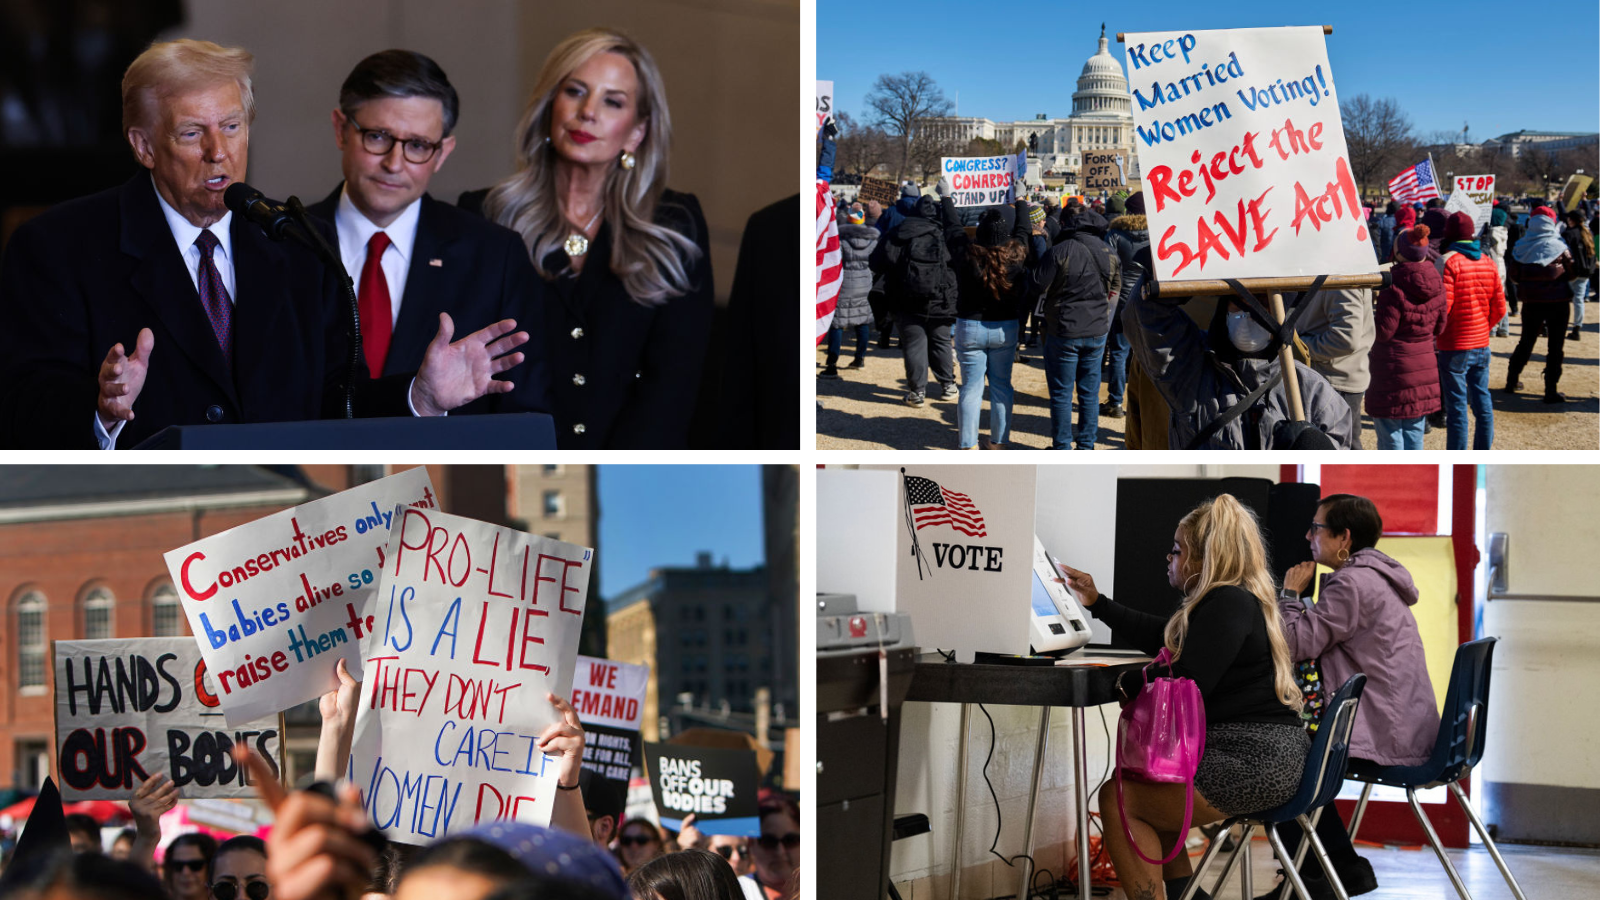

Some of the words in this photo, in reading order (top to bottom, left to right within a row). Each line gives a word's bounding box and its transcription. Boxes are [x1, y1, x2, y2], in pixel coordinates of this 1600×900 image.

[1127, 33, 1196, 70] Keep
[1132, 51, 1244, 112] Married
[1137, 101, 1232, 147] Women
[1237, 64, 1330, 111] Voting!
[945, 157, 1008, 172] CONGRESS?
[952, 171, 1014, 190] COWARDS!
[1085, 152, 1115, 165] FORK
[1085, 176, 1118, 188] ELON
[1146, 131, 1264, 213] Reject
[1269, 118, 1323, 161] the
[950, 191, 986, 206] STAND
[1457, 176, 1493, 190] STOP
[1157, 186, 1280, 278] SAVE
[1290, 156, 1368, 242] Act!
[181, 517, 348, 602] Conservatives
[355, 501, 393, 534] only
[932, 542, 1003, 573] VOTE
[199, 598, 290, 650] babies
[295, 572, 344, 613] alive
[348, 569, 374, 590] so
[384, 584, 416, 652] IS
[430, 597, 462, 660] A
[473, 601, 551, 677] LIE,
[217, 650, 290, 695] raise
[286, 624, 348, 663] them
[589, 662, 619, 690] WE
[66, 653, 182, 716] HANDS
[367, 655, 440, 717] THEY
[444, 673, 522, 724] DON'T
[571, 688, 639, 722] EMAND
[60, 727, 151, 791] OUR
[167, 729, 280, 788] BODIES
[434, 720, 515, 773] CARE
[515, 734, 554, 777] IF
[659, 756, 702, 778] BANS
[349, 753, 463, 838] WOMEN
[660, 773, 689, 793] OFF
[688, 777, 735, 798] OUR
[662, 790, 727, 815] BODIES
